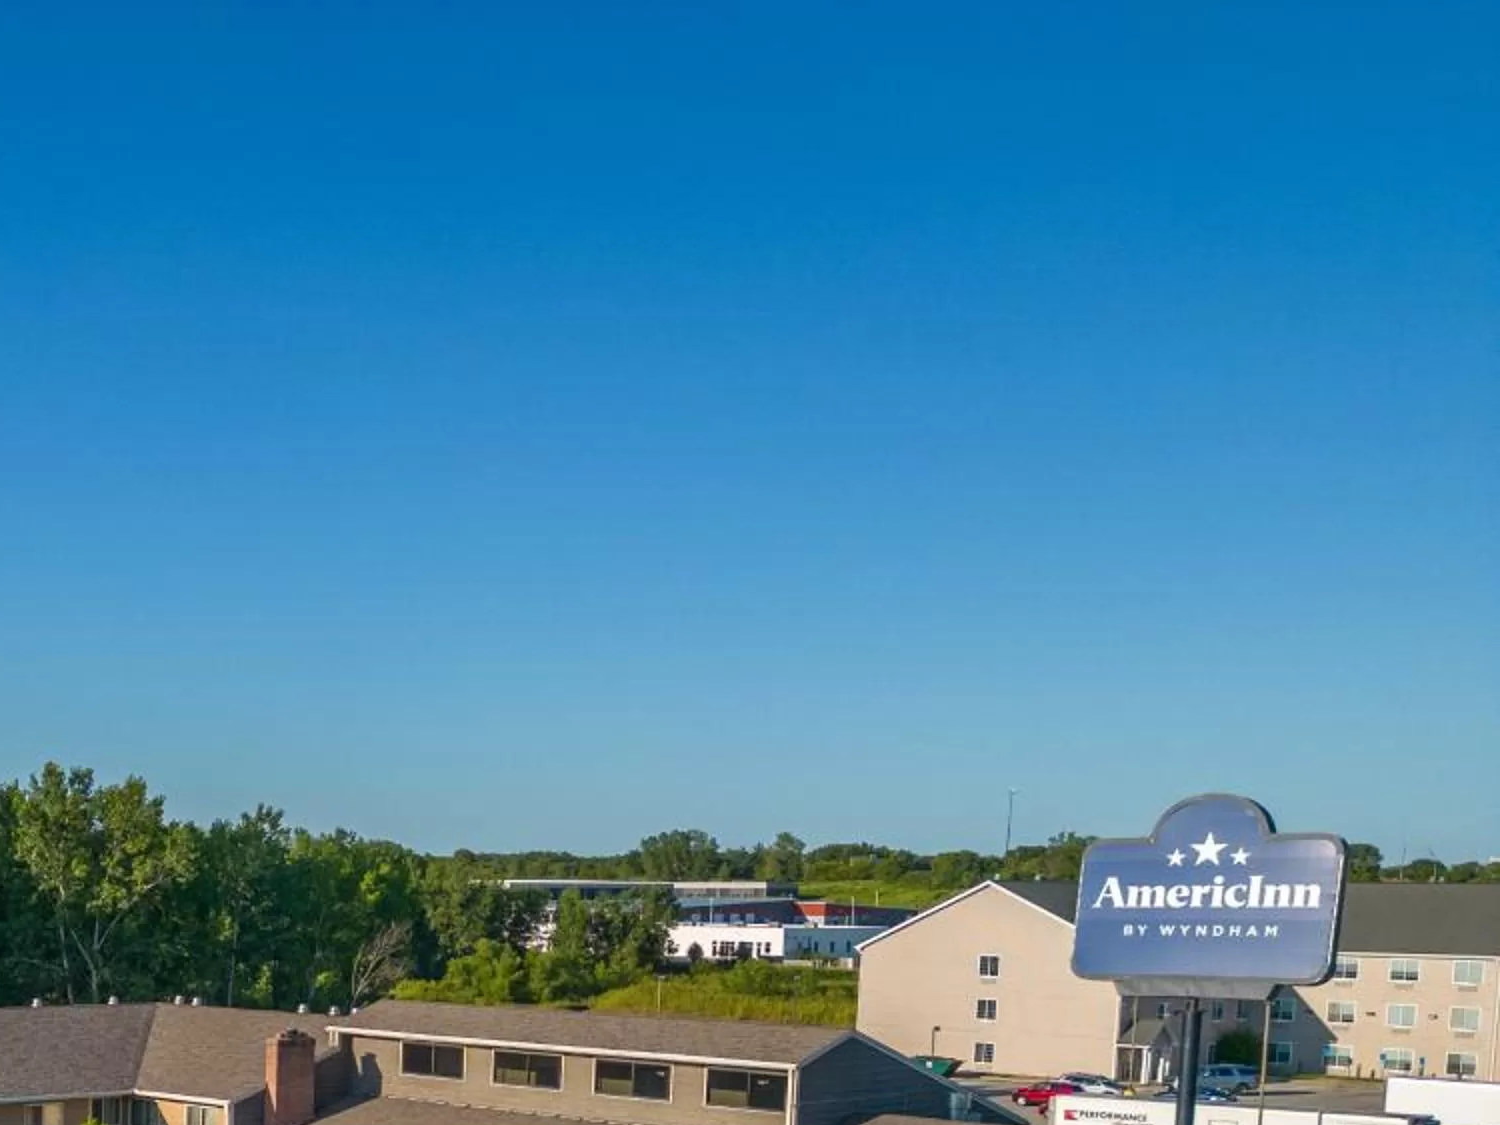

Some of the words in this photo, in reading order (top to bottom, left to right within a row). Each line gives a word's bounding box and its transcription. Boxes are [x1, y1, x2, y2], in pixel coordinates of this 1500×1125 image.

[1092, 875, 1321, 909] AmericInn
[1123, 924, 1148, 937] BY
[1159, 924, 1280, 937] WYNDHAM
[1079, 1109, 1148, 1122] PERFORMANCE
